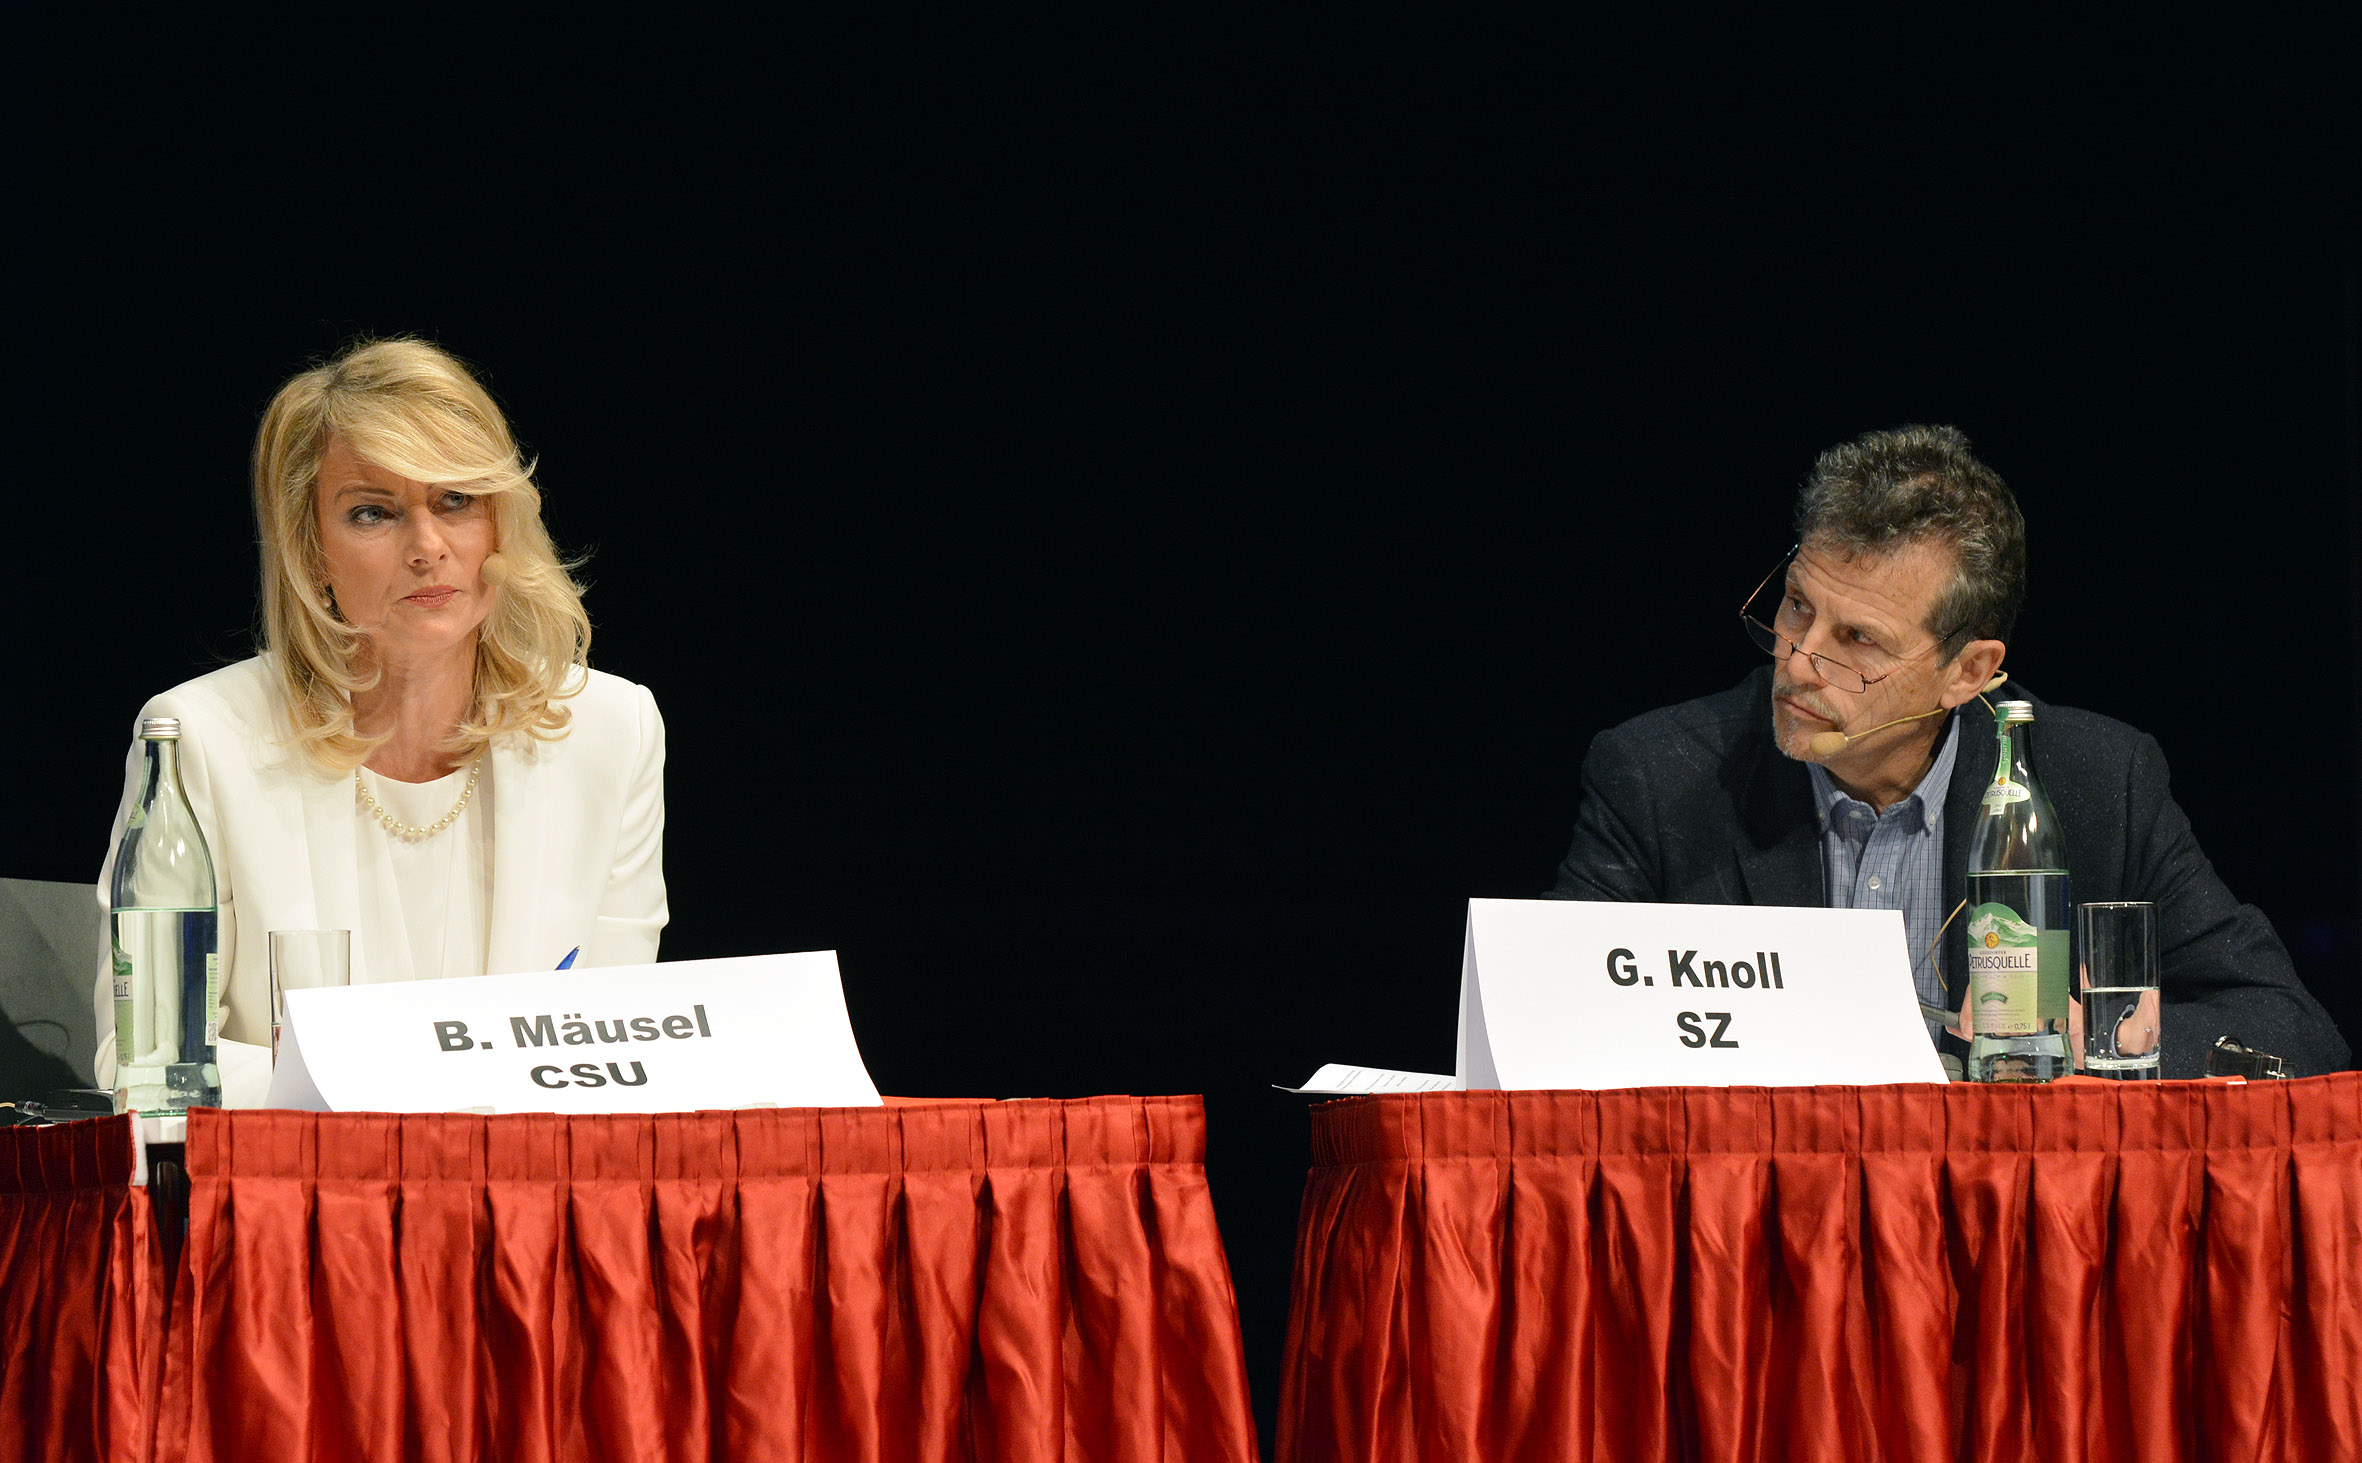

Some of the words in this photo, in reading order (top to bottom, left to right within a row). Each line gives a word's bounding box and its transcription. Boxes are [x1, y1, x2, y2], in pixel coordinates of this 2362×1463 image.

[1606, 947, 1654, 987] G.
[1668, 949, 1784, 989] Knoll
[433, 1020, 493, 1052] B.
[509, 1004, 712, 1048] Mäusel
[1676, 1011, 1740, 1049] SZ
[530, 1060, 648, 1089] CSU
